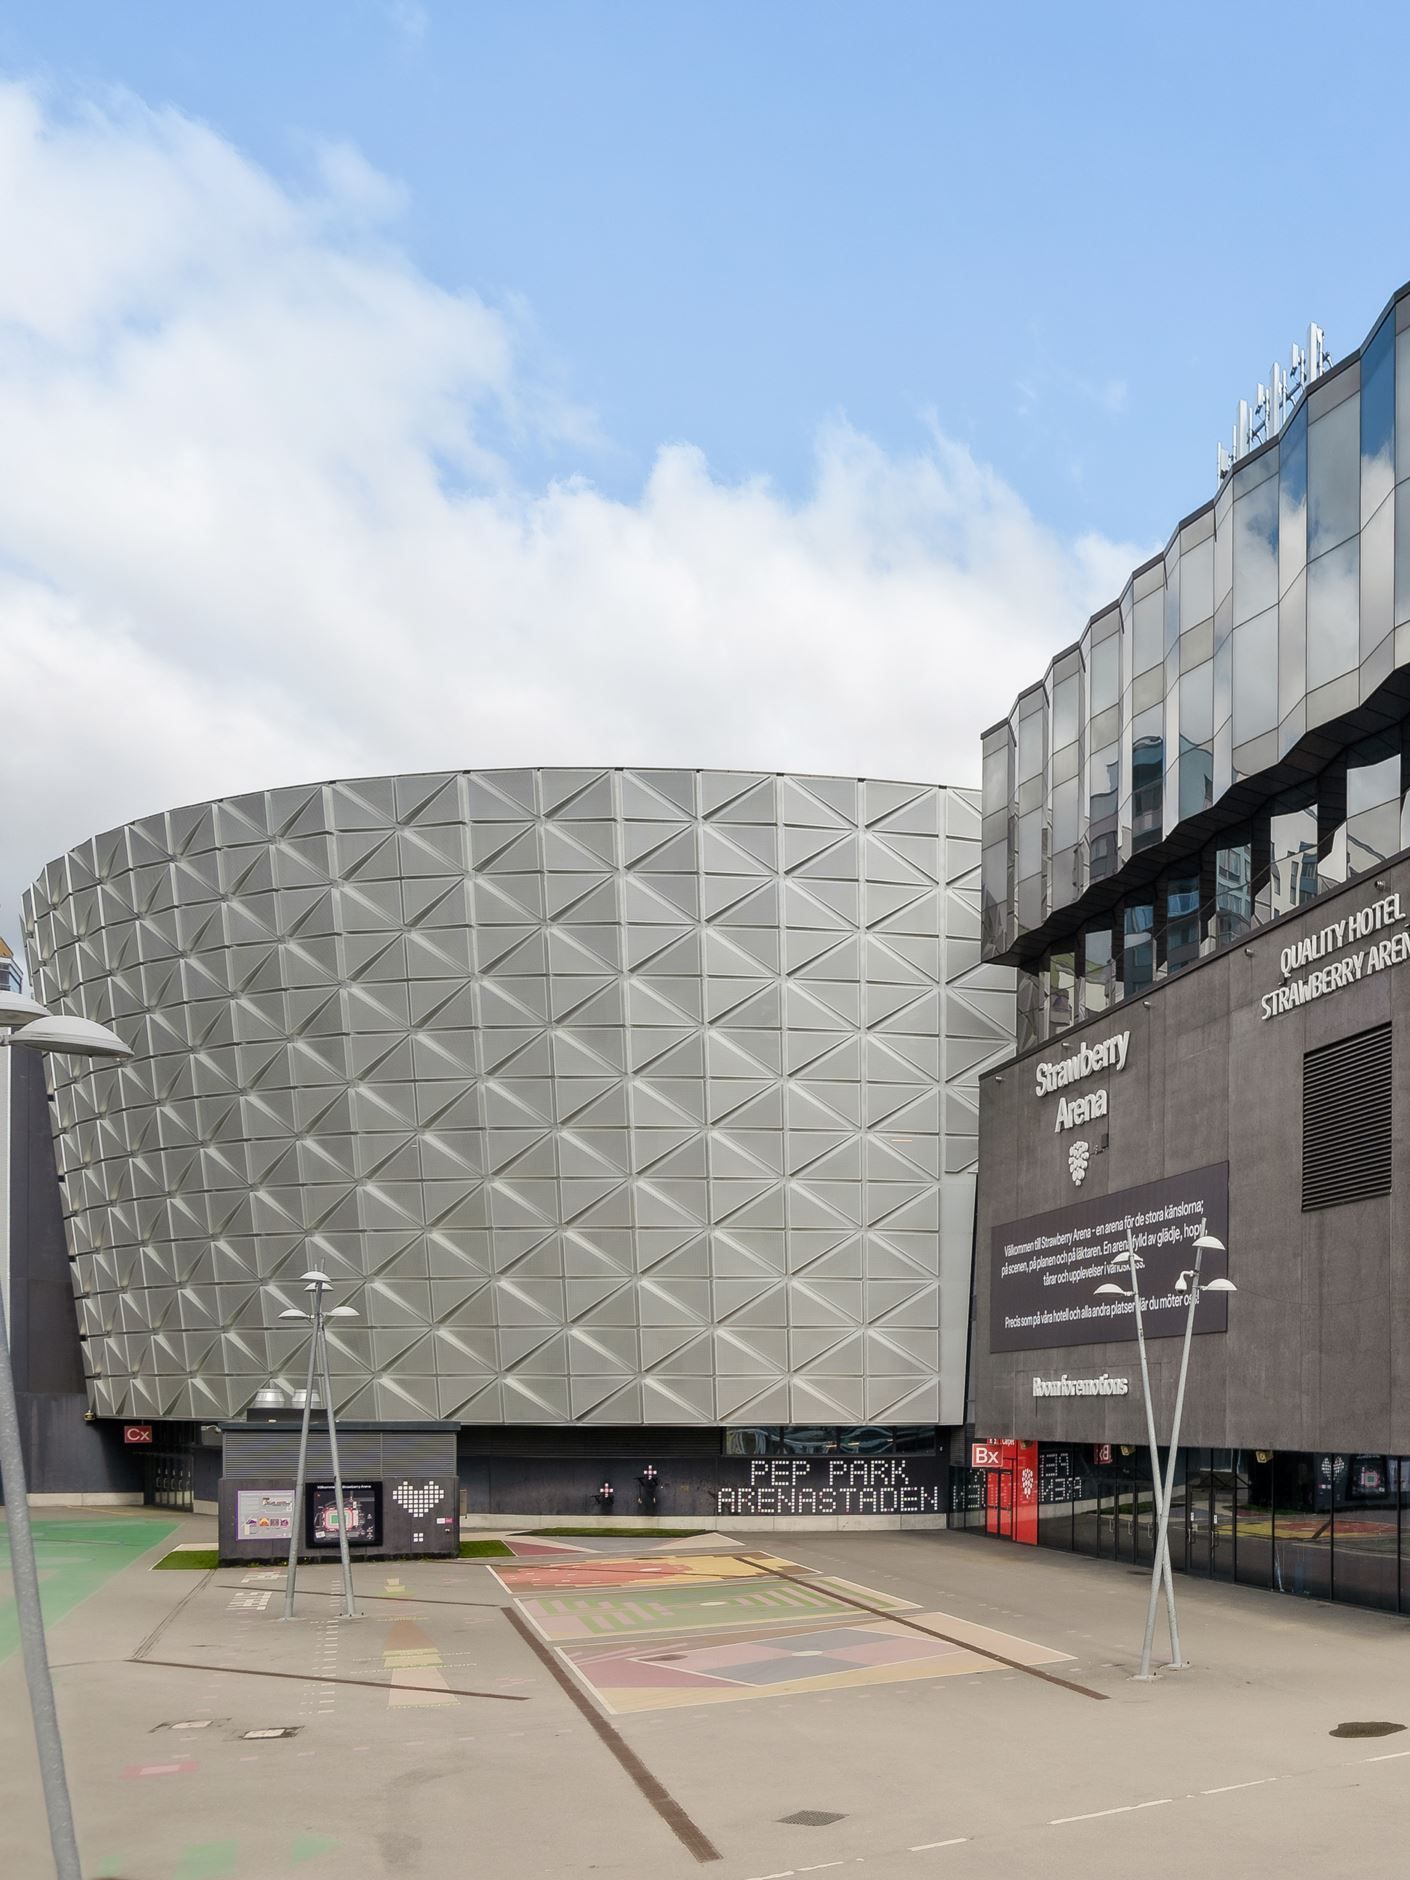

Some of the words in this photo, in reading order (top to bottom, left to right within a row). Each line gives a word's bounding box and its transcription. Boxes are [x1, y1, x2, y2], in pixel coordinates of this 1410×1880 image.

[1280, 919, 1346, 978] QUALITY
[1349, 893, 1407, 942] HOTEL
[1261, 951, 1365, 1020] STRAWBERRY
[1035, 1030, 1131, 1097] Strawberry
[1055, 1089, 1108, 1133] Arena
[1004, 1242, 1034, 1257] Välkommen
[1041, 1232, 1073, 1249] Strawberry
[1073, 1228, 1091, 1241] Arena
[1096, 1225, 1104, 1236] en
[1105, 1220, 1123, 1234] arena
[1124, 1215, 1134, 1229] för
[1135, 1212, 1144, 1227] de
[1145, 1210, 1163, 1224] stora
[1165, 1200, 1204, 1219] känslorna;
[1001, 1262, 1008, 1278] på
[1009, 1262, 1028, 1274] scenen,
[1029, 1256, 1036, 1273] på
[1036, 1255, 1056, 1271] planen
[1056, 1250, 1067, 1264] och
[1068, 1247, 1076, 1265] på
[1076, 1246, 1102, 1260] läktaren.
[1103, 1241, 1112, 1254] En
[1132, 1232, 1147, 1251] fylld
[1148, 1233, 1156, 1245] av
[1157, 1225, 1183, 1247] glädje,
[1183, 1223, 1207, 1239] hop,
[1043, 1272, 1057, 1286] tårar
[1057, 1269, 1068, 1283] och
[1069, 1264, 1103, 1283] upplevelser
[1005, 1315, 1020, 1328] Precis
[1021, 1316, 1033, 1326] som
[1033, 1310, 1040, 1328] på
[1041, 1309, 1053, 1324] våra
[1053, 1307, 1069, 1322] hotell
[1069, 1306, 1080, 1320] och
[1081, 1305, 1091, 1319] alla
[1092, 1302, 1110, 1317] andra
[1111, 1301, 1136, 1318] platser
[1149, 1296, 1159, 1310] du
[1160, 1293, 1184, 1308] möter
[1033, 1377, 1061, 1396] Room
[1061, 1374, 1076, 1396] for
[1076, 1374, 1128, 1396] emotions
[127, 1428, 150, 1441] Cx
[751, 1460, 810, 1486] PEP
[829, 1460, 909, 1486] PARK
[975, 1447, 999, 1464] Bx
[718, 1486, 938, 1513] ARENASTADEN
